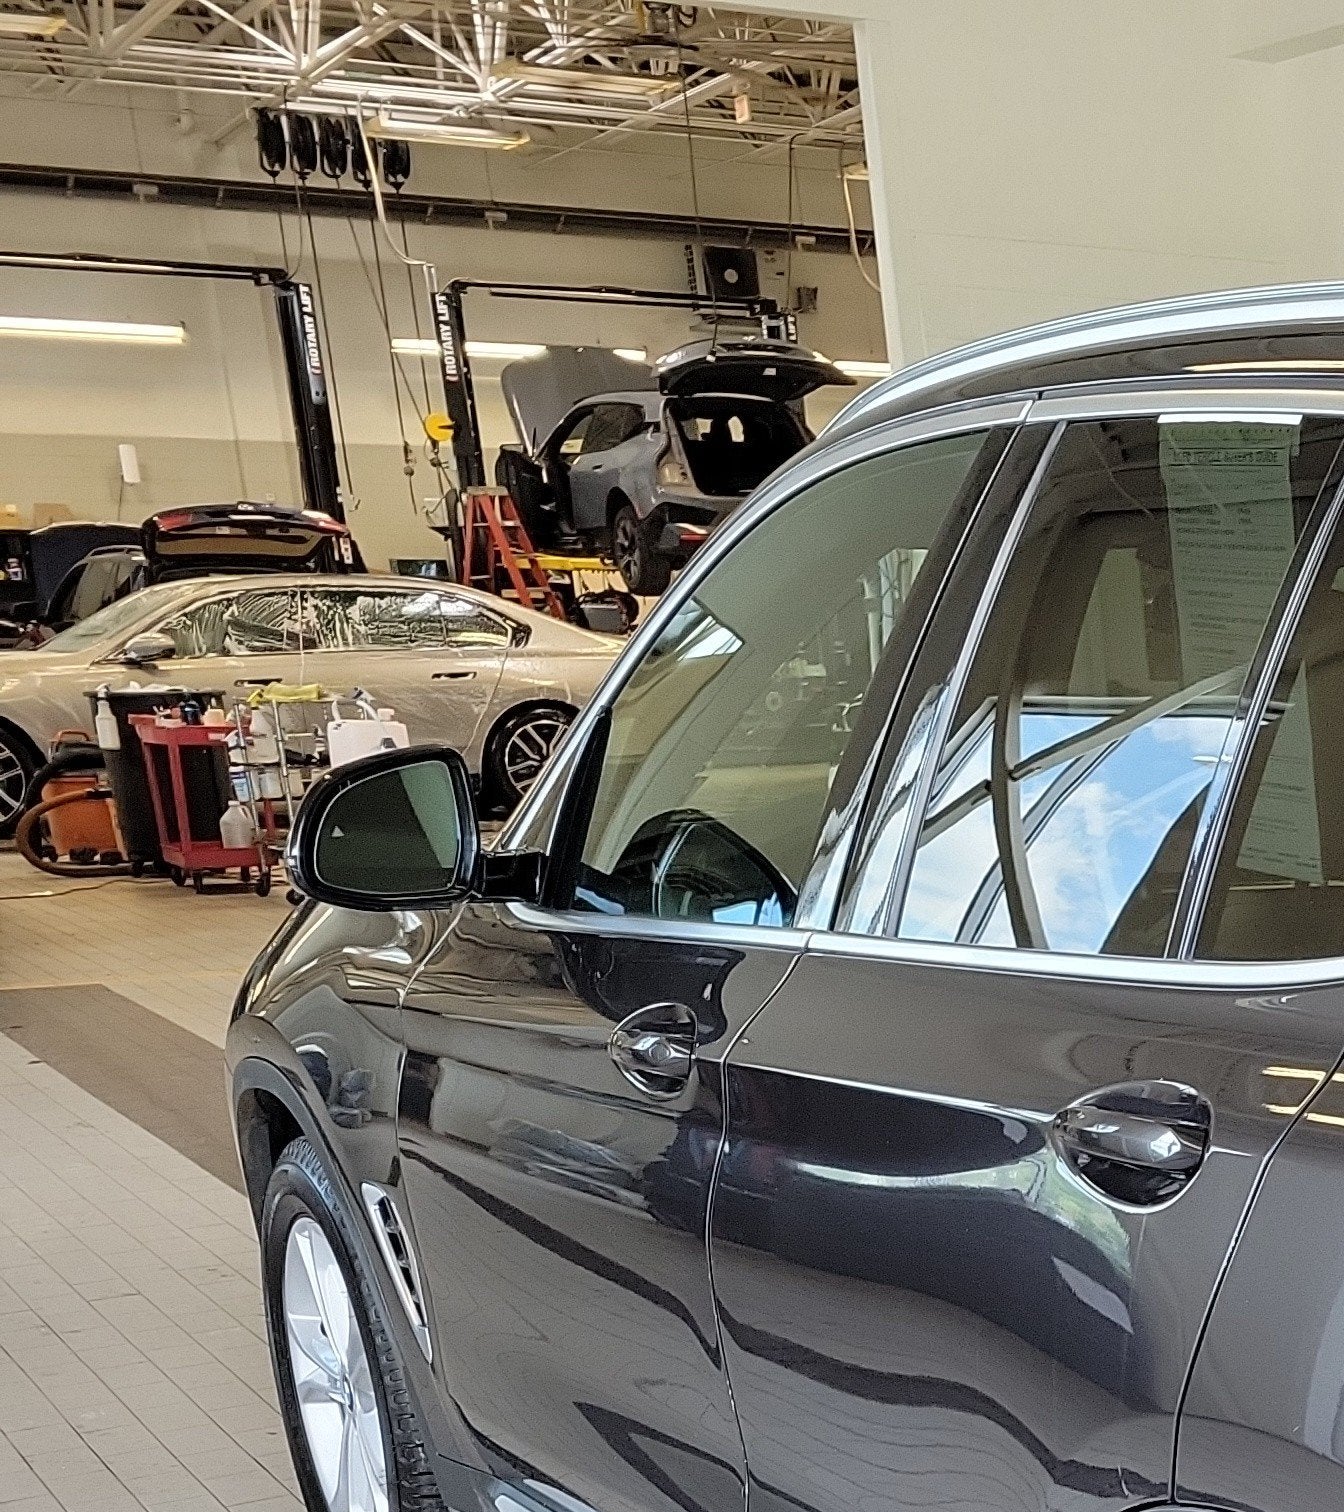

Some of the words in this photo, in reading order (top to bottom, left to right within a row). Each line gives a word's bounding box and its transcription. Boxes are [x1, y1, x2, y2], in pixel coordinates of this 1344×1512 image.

[299, 284, 313, 312] LIFT
[436, 294, 450, 321] LIFT
[303, 314, 322, 367] ROTARY
[439, 323, 458, 374] ROTARY
